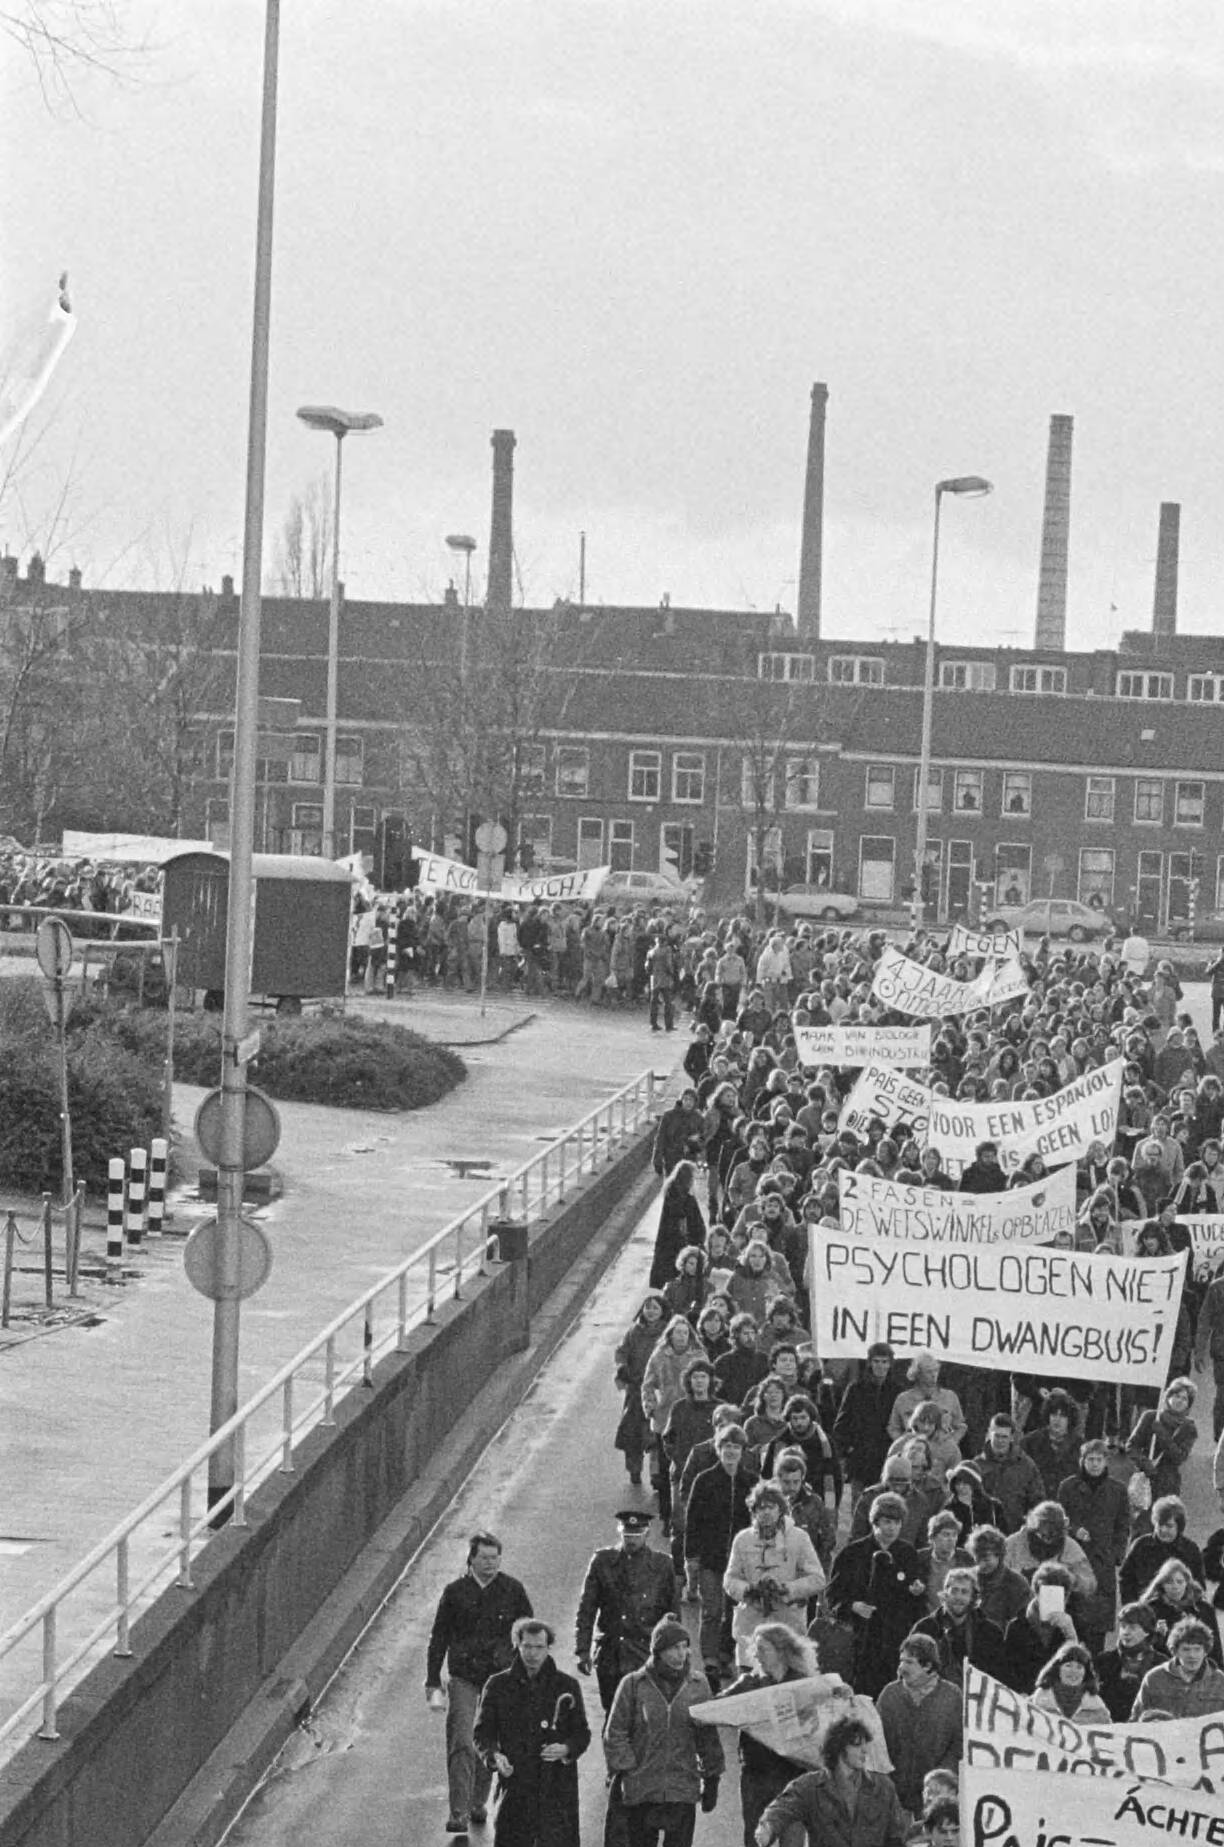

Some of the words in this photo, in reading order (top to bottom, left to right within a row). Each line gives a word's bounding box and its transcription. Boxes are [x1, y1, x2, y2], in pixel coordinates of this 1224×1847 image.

[955, 927, 1020, 953] TEGEN
[933, 1111, 977, 1138] VOOR
[987, 1111, 1025, 1138] EEN
[1037, 1122, 1082, 1156] GEEN
[825, 1243, 1093, 1297] PSYCHOLOGEN
[1106, 1265, 1180, 1303] NIET
[831, 1305, 869, 1343] IN
[886, 1310, 952, 1349] EEN
[971, 1315, 1164, 1364] DWANGBUIS!
